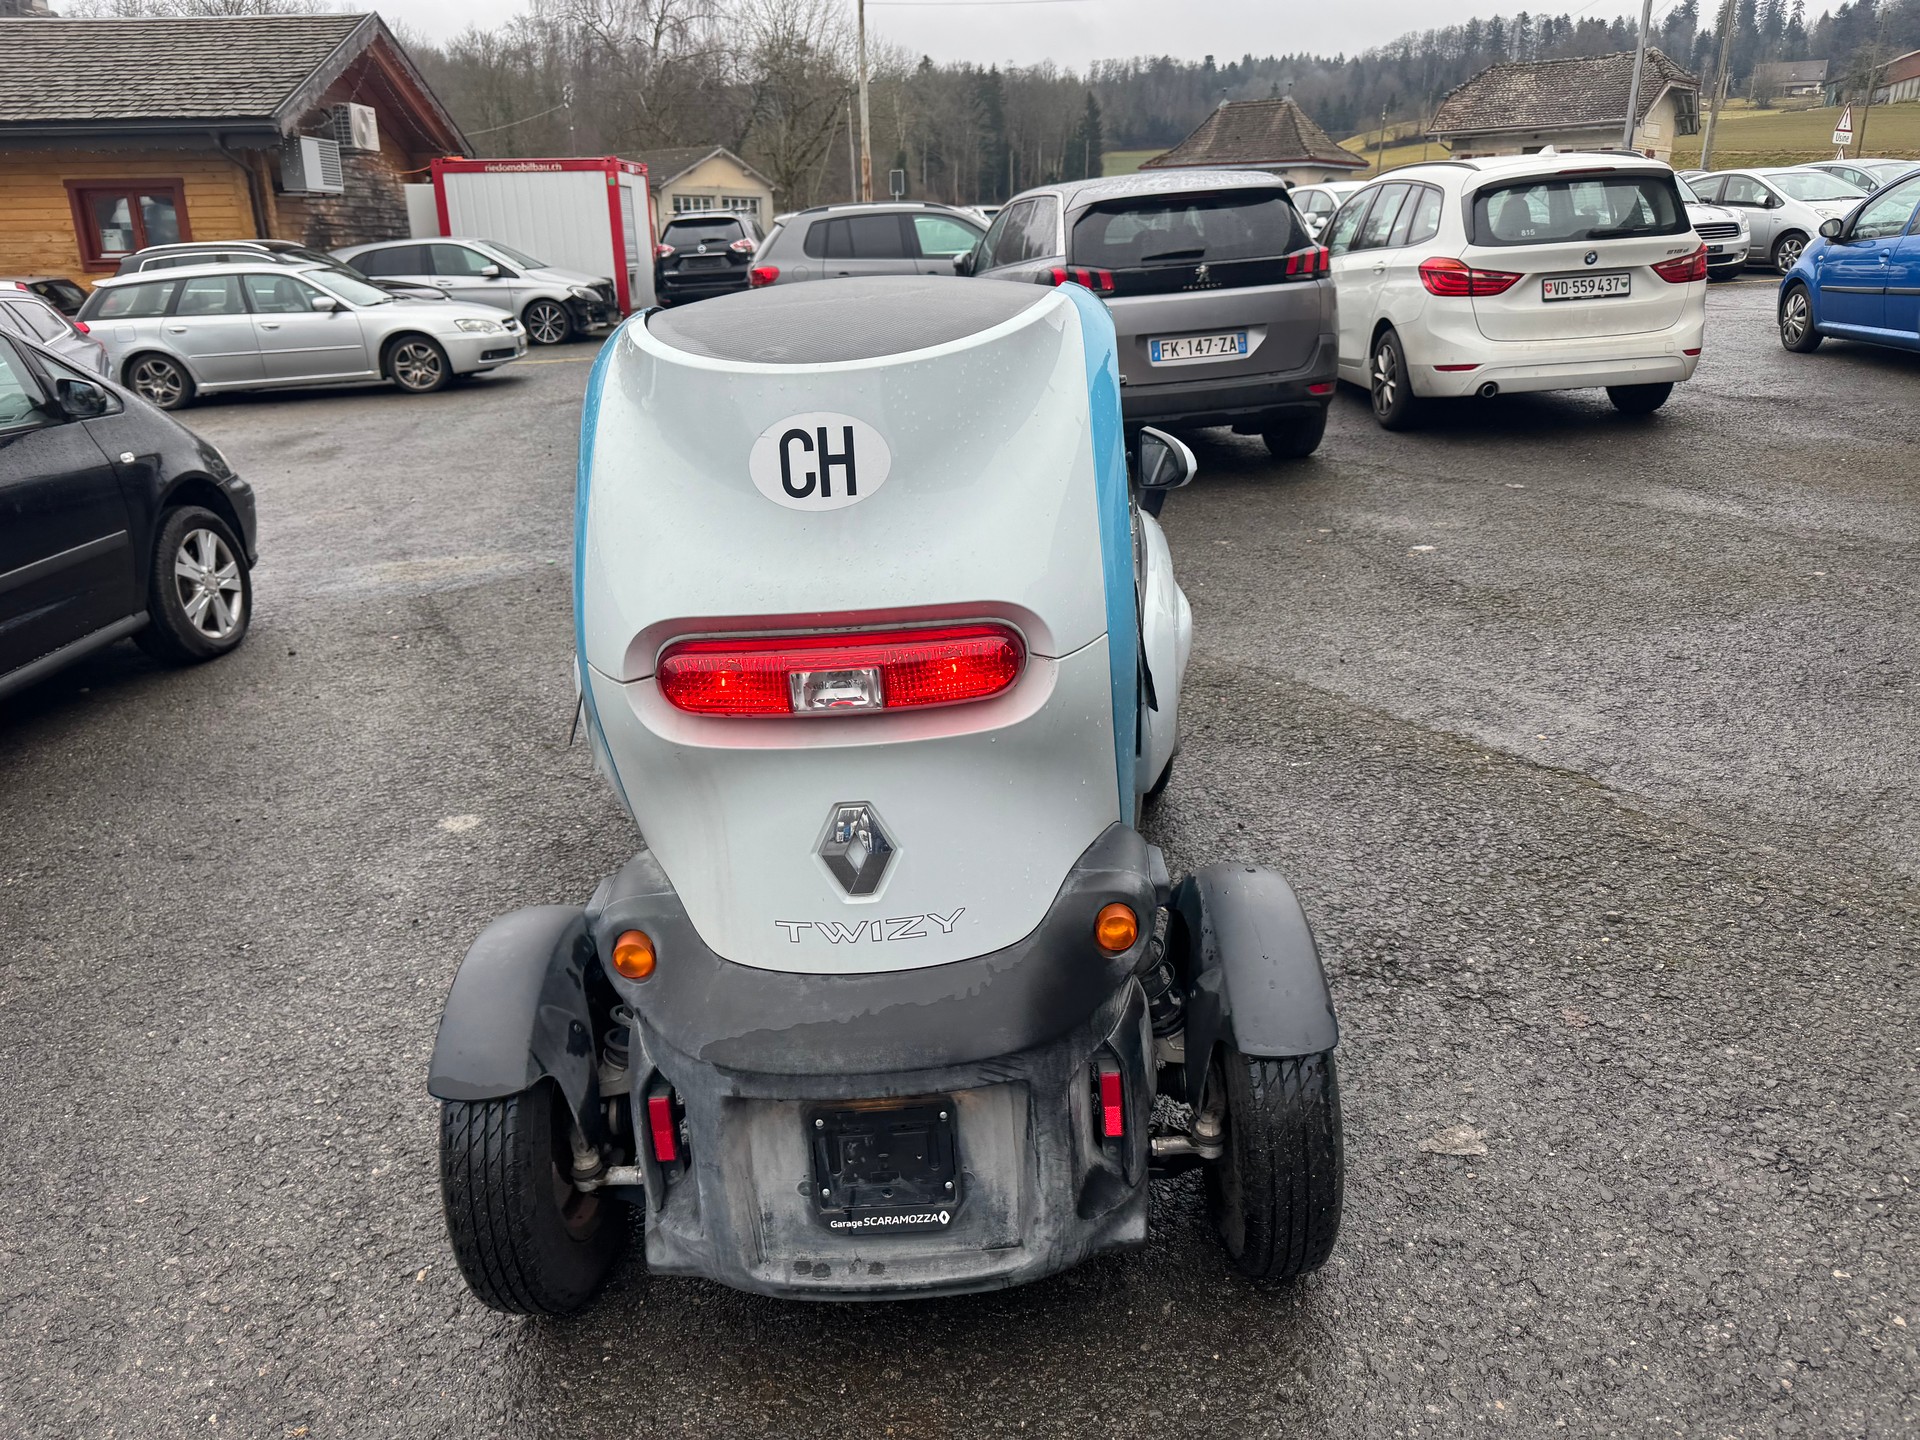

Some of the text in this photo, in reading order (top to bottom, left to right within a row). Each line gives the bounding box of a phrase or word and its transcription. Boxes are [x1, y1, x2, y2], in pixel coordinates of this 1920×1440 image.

[1835, 132, 1850, 142] Usine
[484, 162, 562, 172] riedomobilbau.ch
[779, 425, 857, 499] CH
[775, 907, 965, 943] TWIZY
[830, 1213, 938, 1229] Garage SCARAMOZZA
